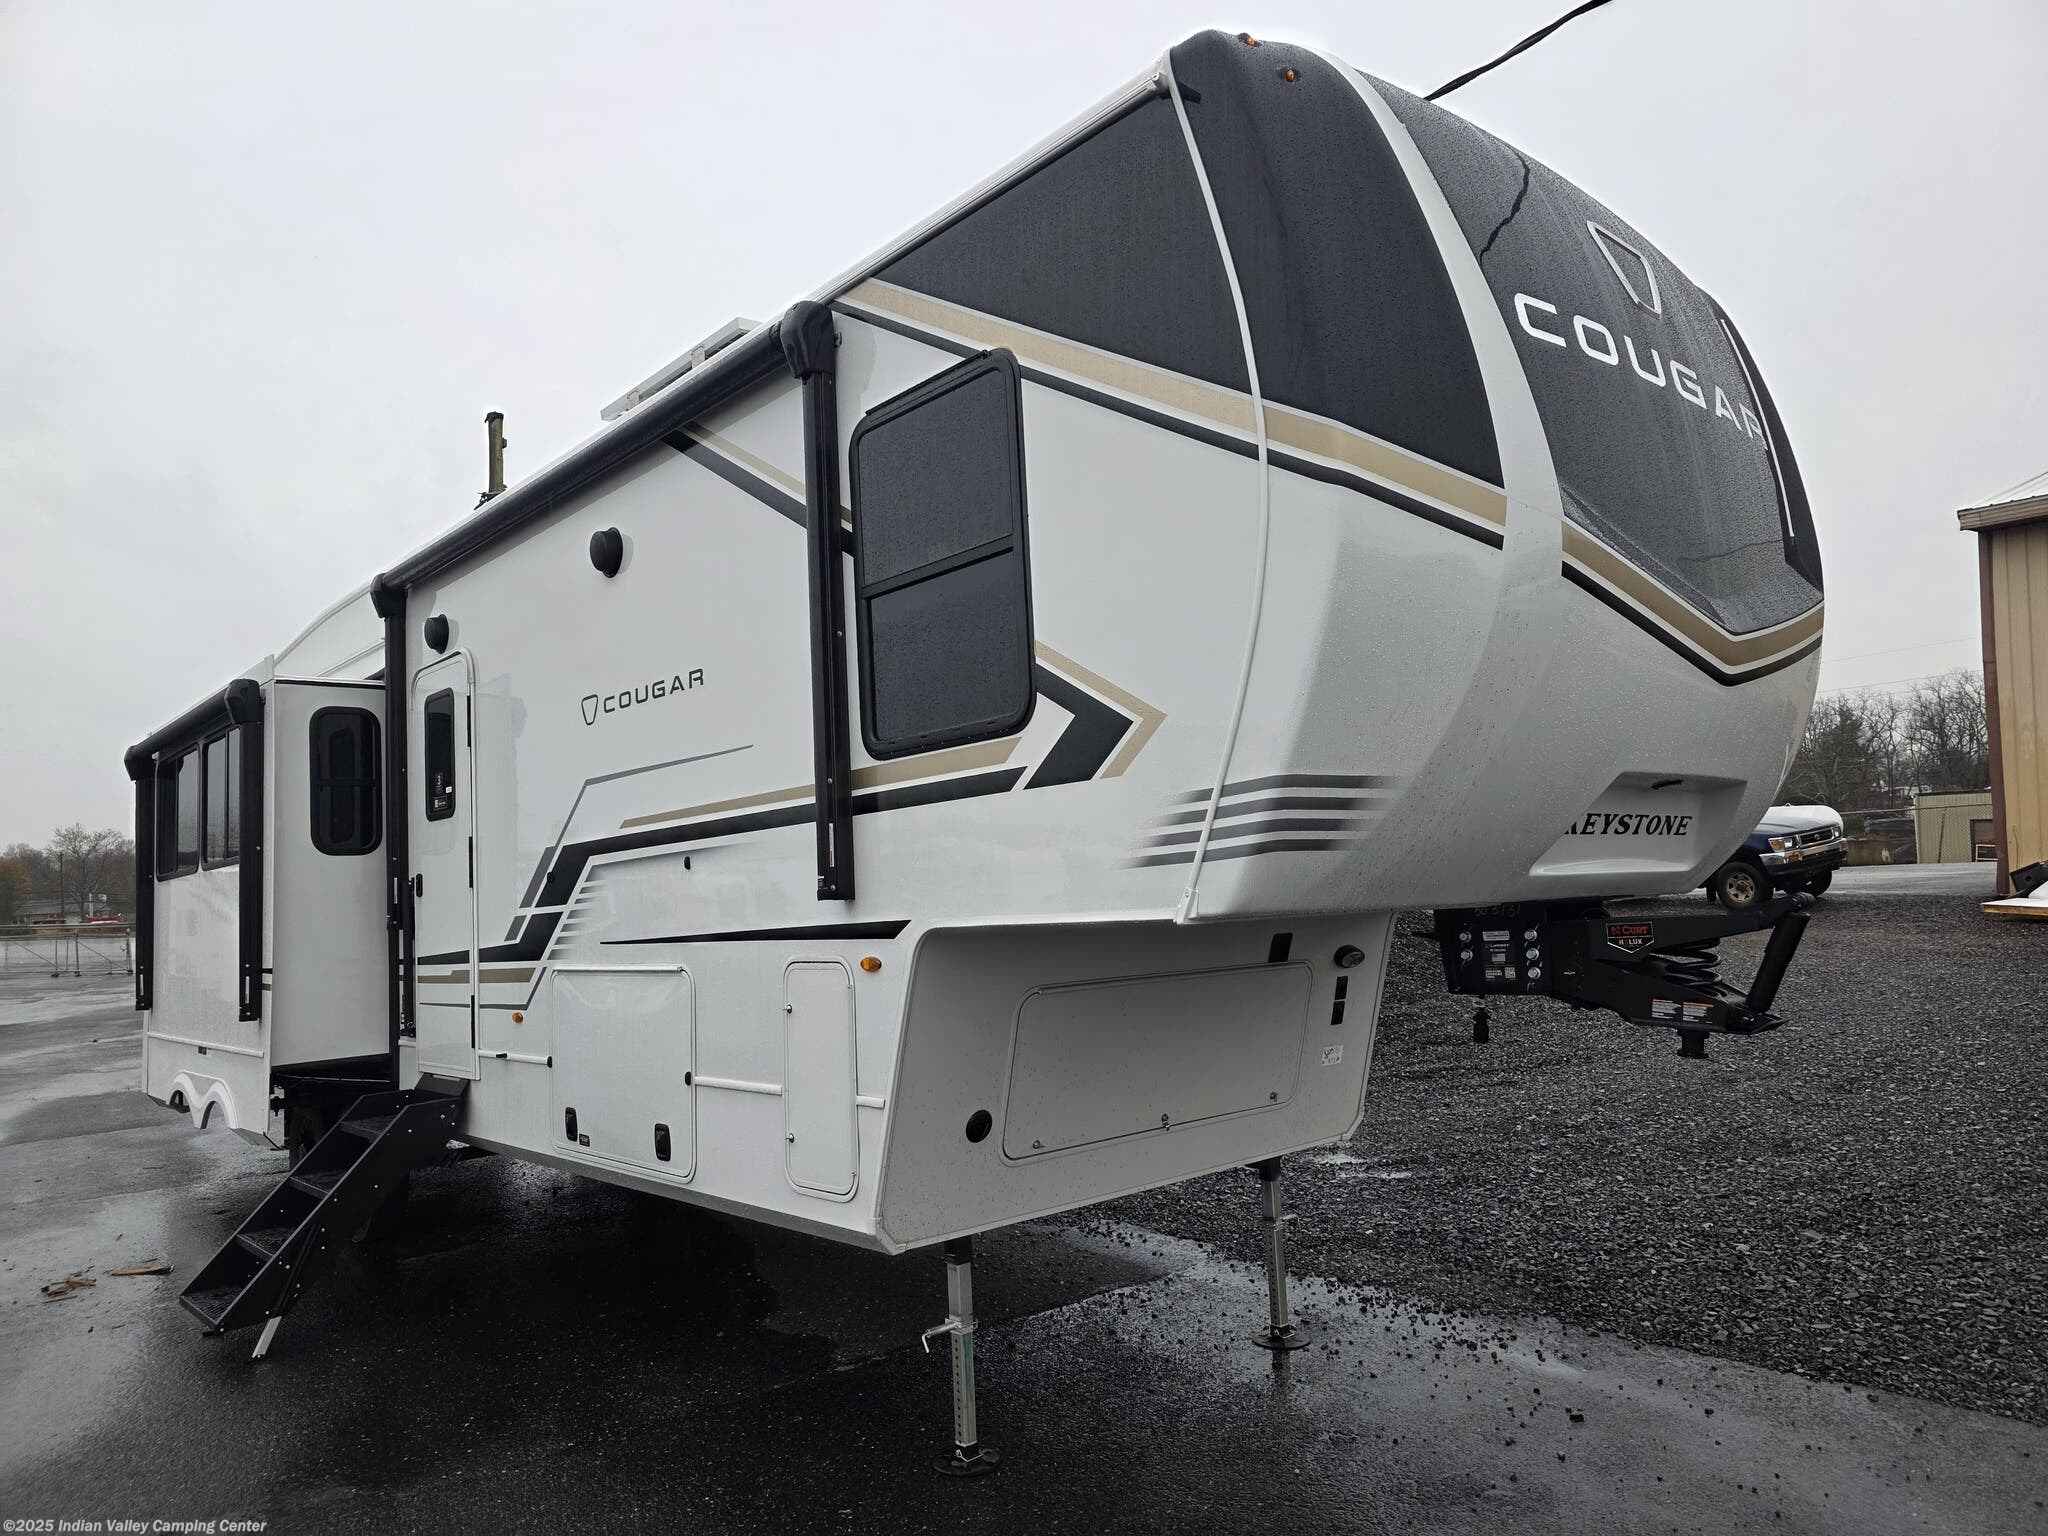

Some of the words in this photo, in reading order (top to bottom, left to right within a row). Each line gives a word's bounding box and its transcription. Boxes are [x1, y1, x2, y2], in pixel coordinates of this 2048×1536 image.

[1514, 292, 1768, 450] COUGAR
[603, 668, 704, 714] COUGAR
[1621, 925, 1649, 935] CURT
